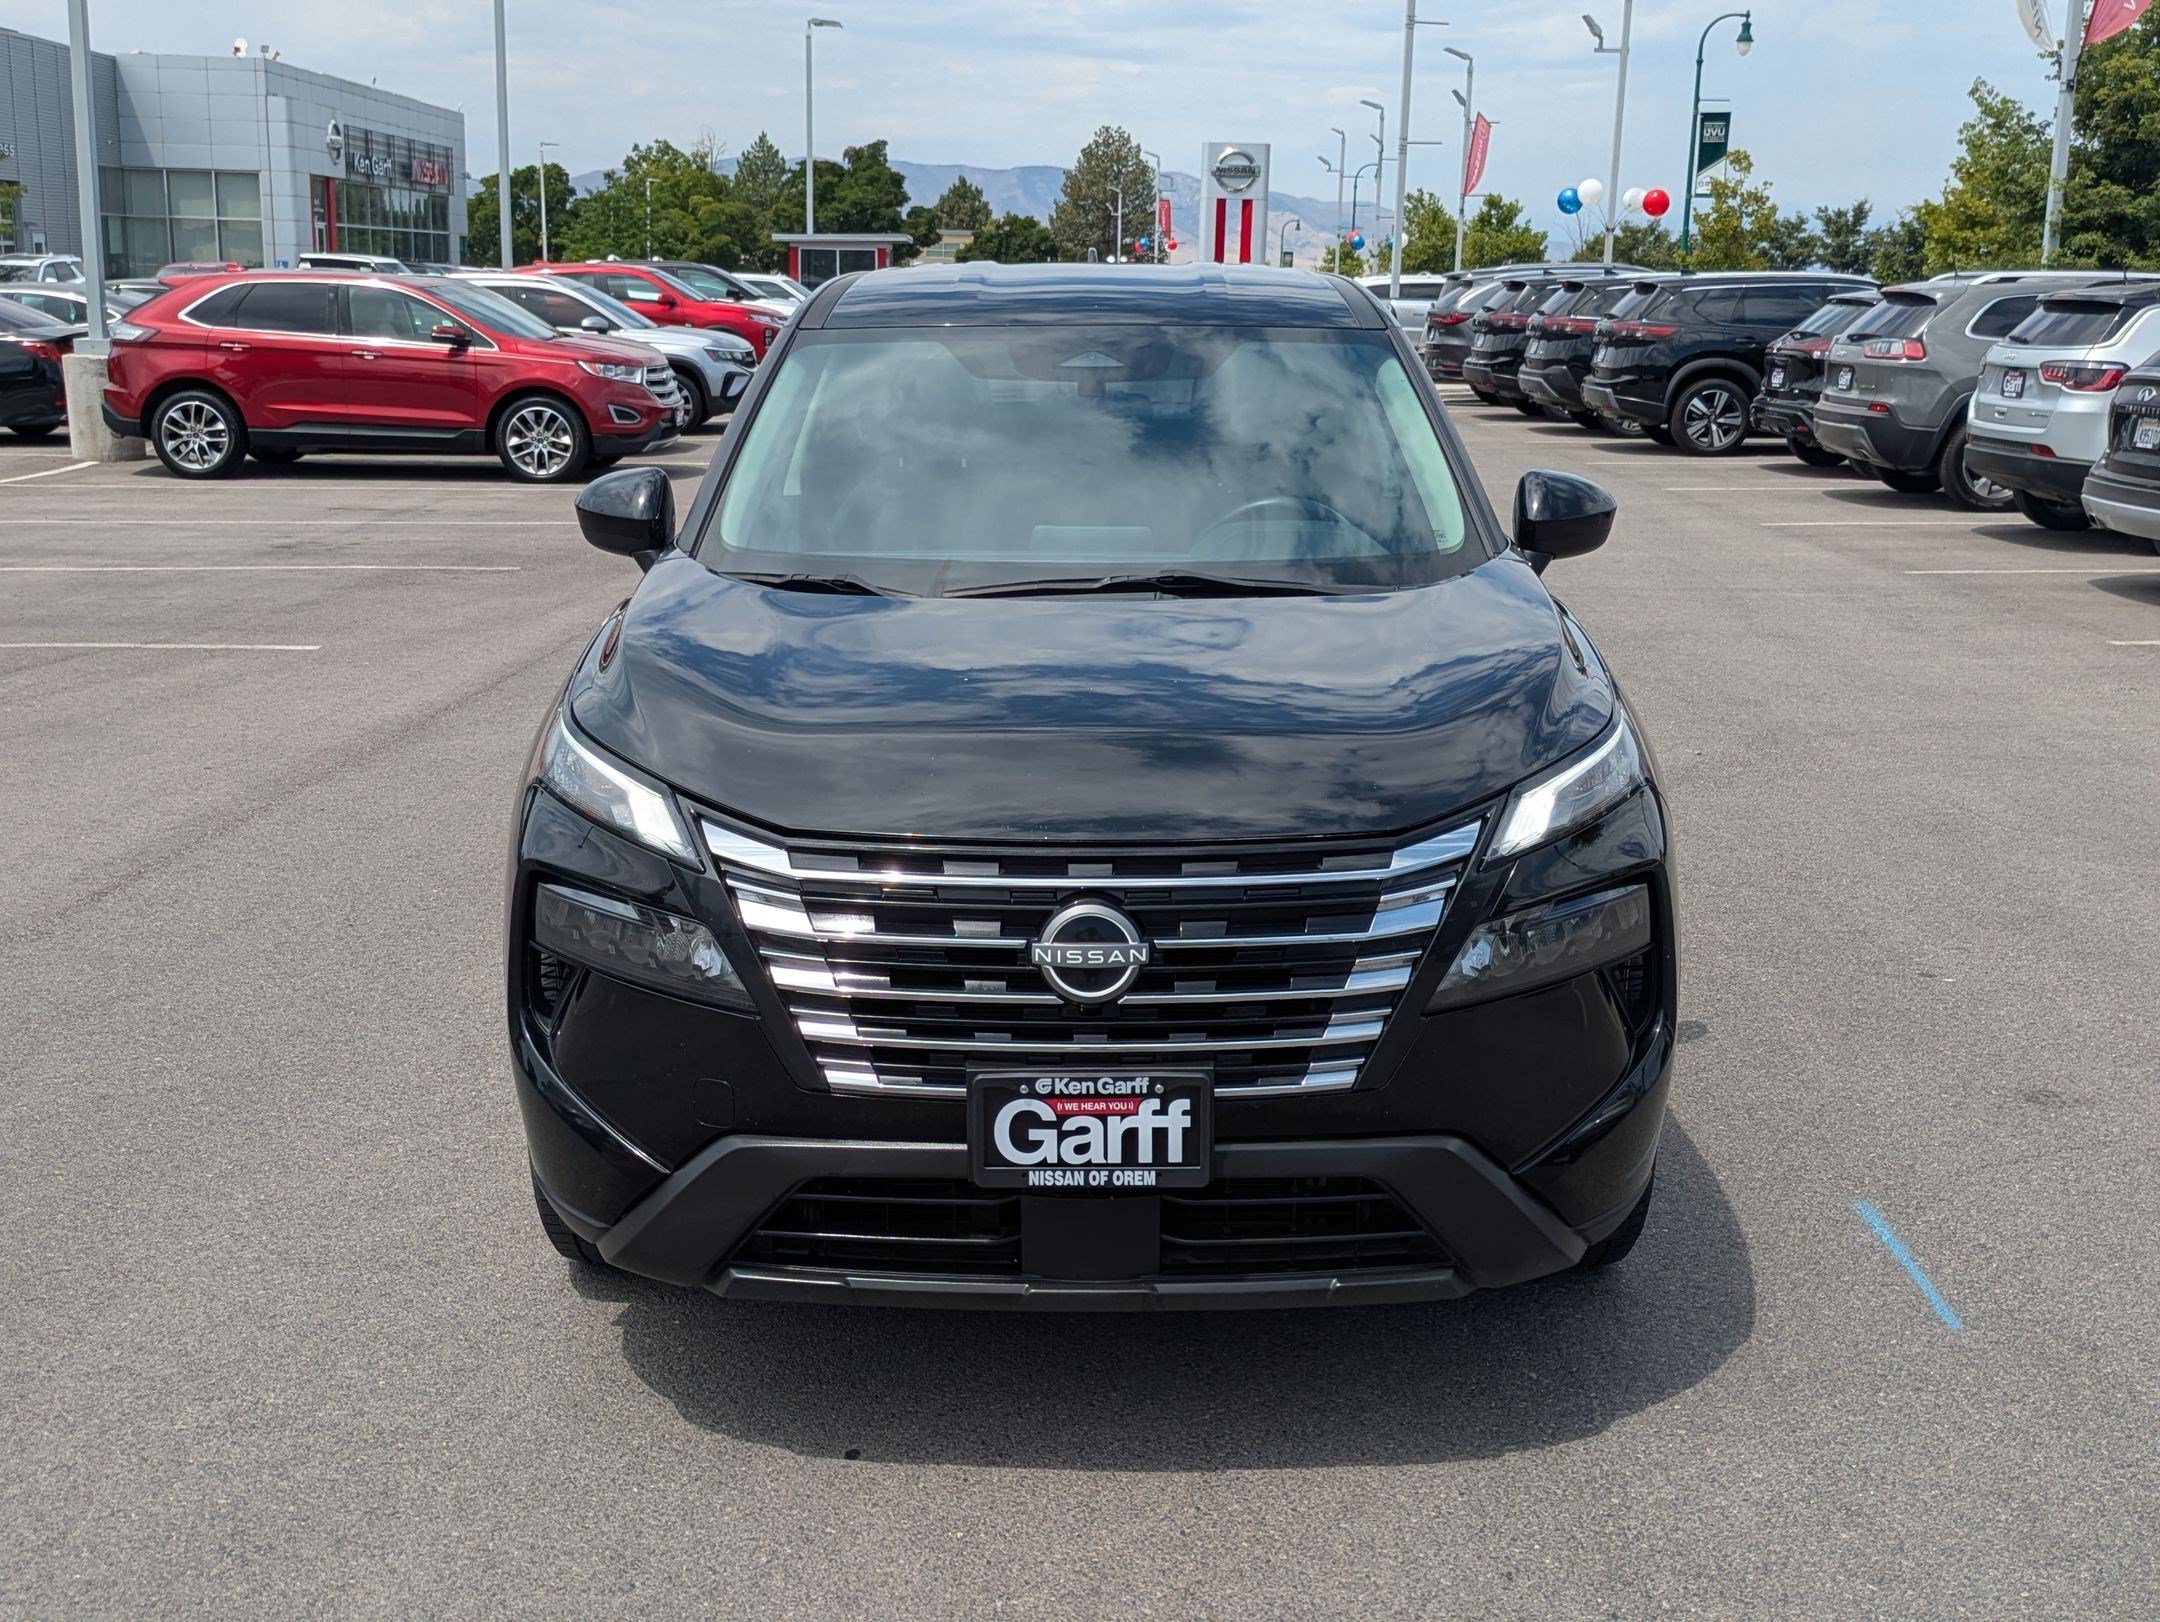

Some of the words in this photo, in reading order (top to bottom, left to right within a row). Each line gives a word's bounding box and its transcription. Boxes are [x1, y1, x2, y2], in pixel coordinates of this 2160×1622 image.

[353, 152, 372, 175] Ken
[372, 156, 393, 177] Garff
[1215, 166, 1257, 175] NISSAN
[2003, 375, 2024, 393] Garff
[1034, 947, 1147, 964] NISSAN
[1054, 1078, 1095, 1095] Ken
[1097, 1077, 1150, 1095] Garff
[1064, 1102, 1080, 1111] WE
[1081, 1102, 1107, 1111] HEAR
[1107, 1101, 1127, 1111] YOU
[993, 1098, 1192, 1165] Garff
[1028, 1170, 1085, 1186] NISSAN
[1088, 1170, 1108, 1186] OF
[1113, 1170, 1157, 1186] OREM
